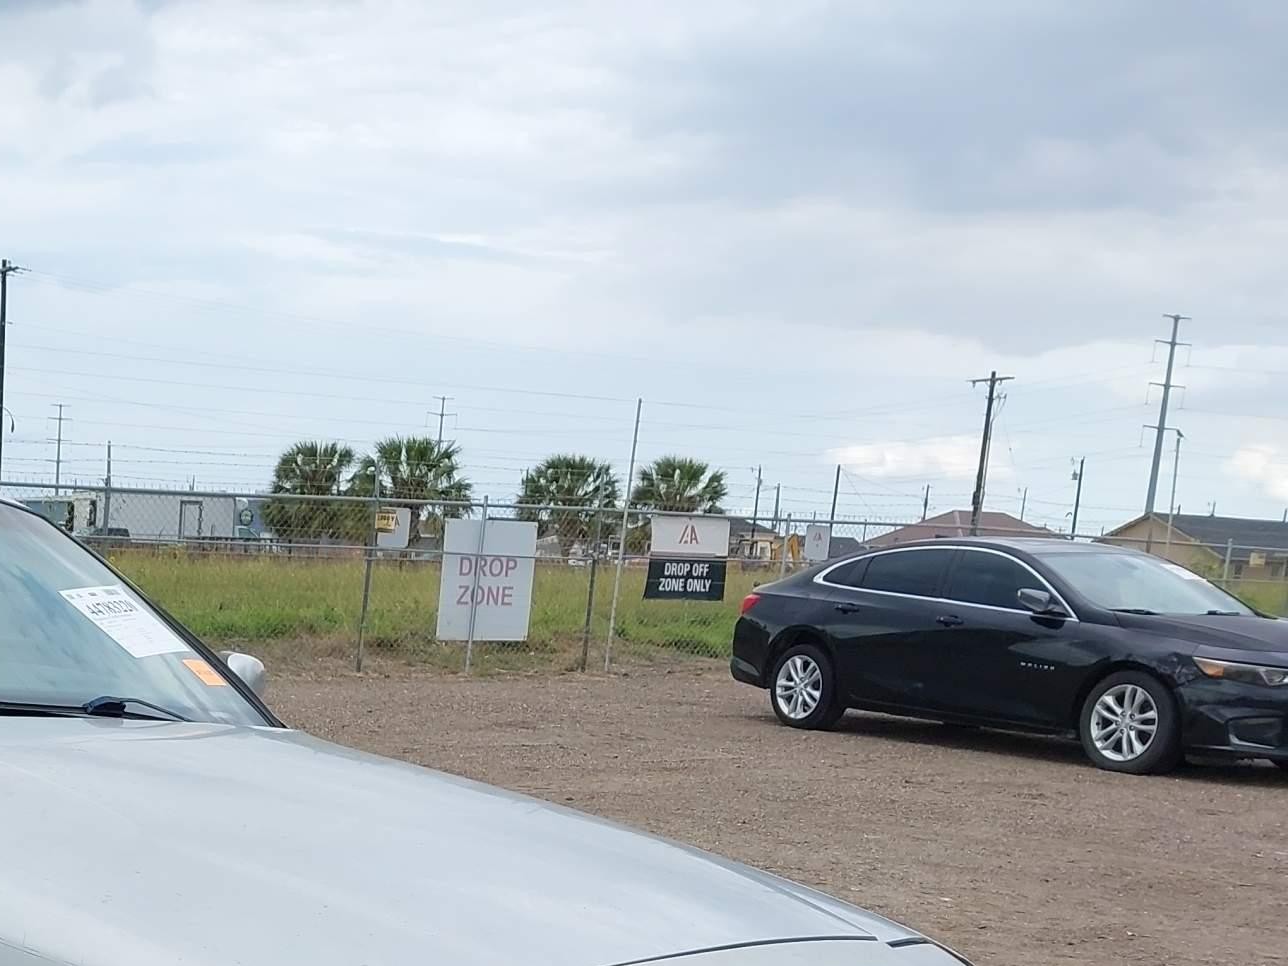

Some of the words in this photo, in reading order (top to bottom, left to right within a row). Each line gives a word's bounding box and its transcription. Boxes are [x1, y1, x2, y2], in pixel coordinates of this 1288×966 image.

[459, 556, 518, 577] DROP
[664, 563, 690, 576] DROP
[692, 564, 709, 576] OFF
[658, 578, 685, 591] ZONE
[686, 579, 712, 592] ONLY
[456, 585, 514, 606] ZONE
